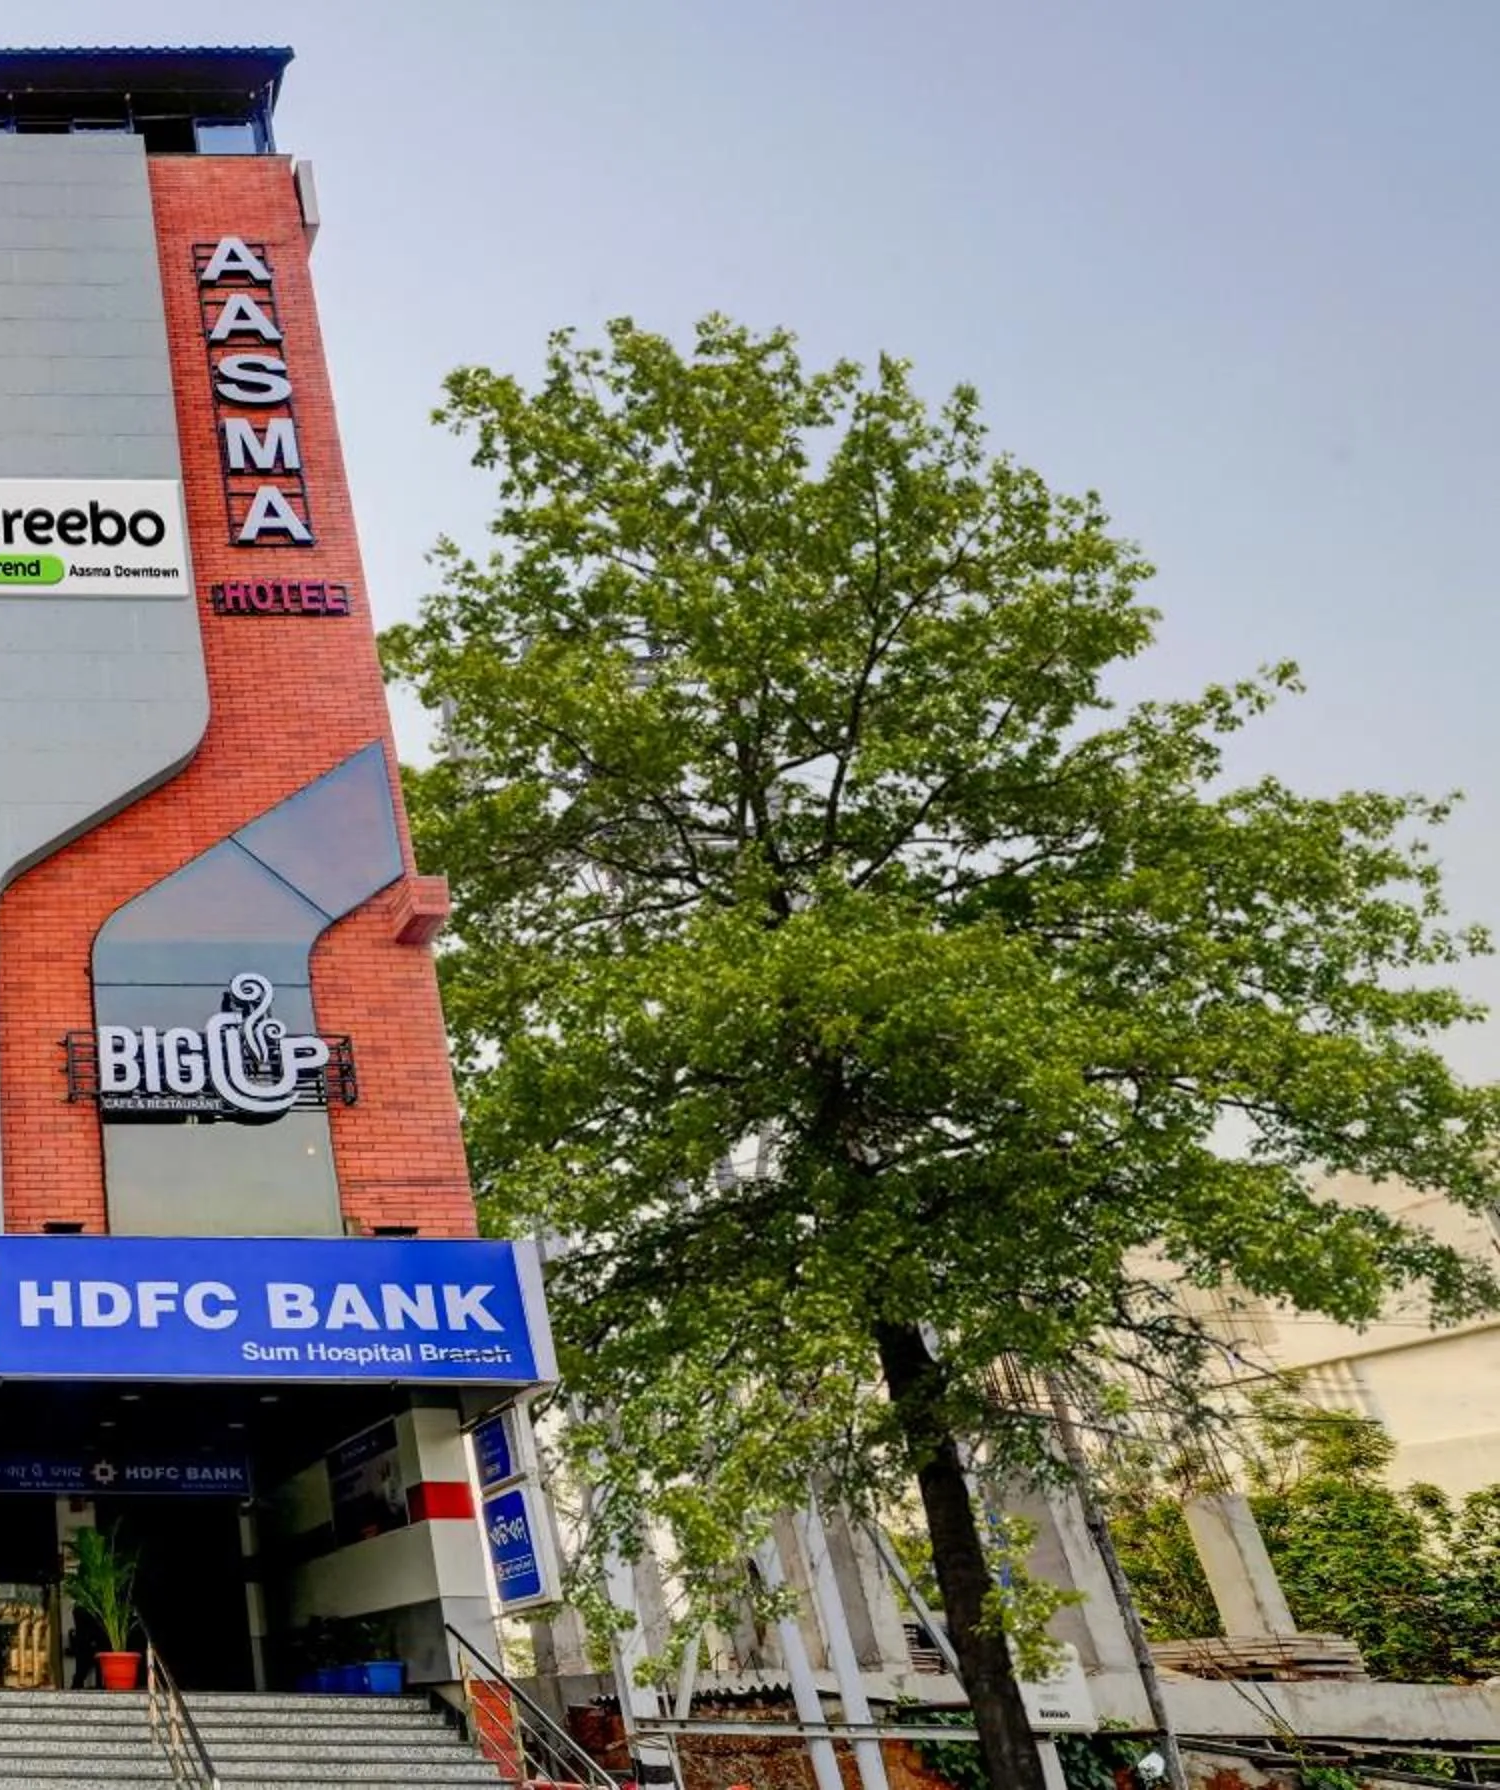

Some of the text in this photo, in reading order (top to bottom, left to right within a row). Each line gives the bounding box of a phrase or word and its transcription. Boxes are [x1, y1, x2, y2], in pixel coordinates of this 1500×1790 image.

[201, 237, 314, 545] AASMA
[69, 564, 179, 578] Aasma Downtown
[223, 578, 348, 613] HOTEL
[20, 1280, 505, 1332] HDFC BANK
[242, 1341, 299, 1361] Sum
[307, 1342, 413, 1366] Hospital
[124, 1466, 244, 1481] HDFC BANK
